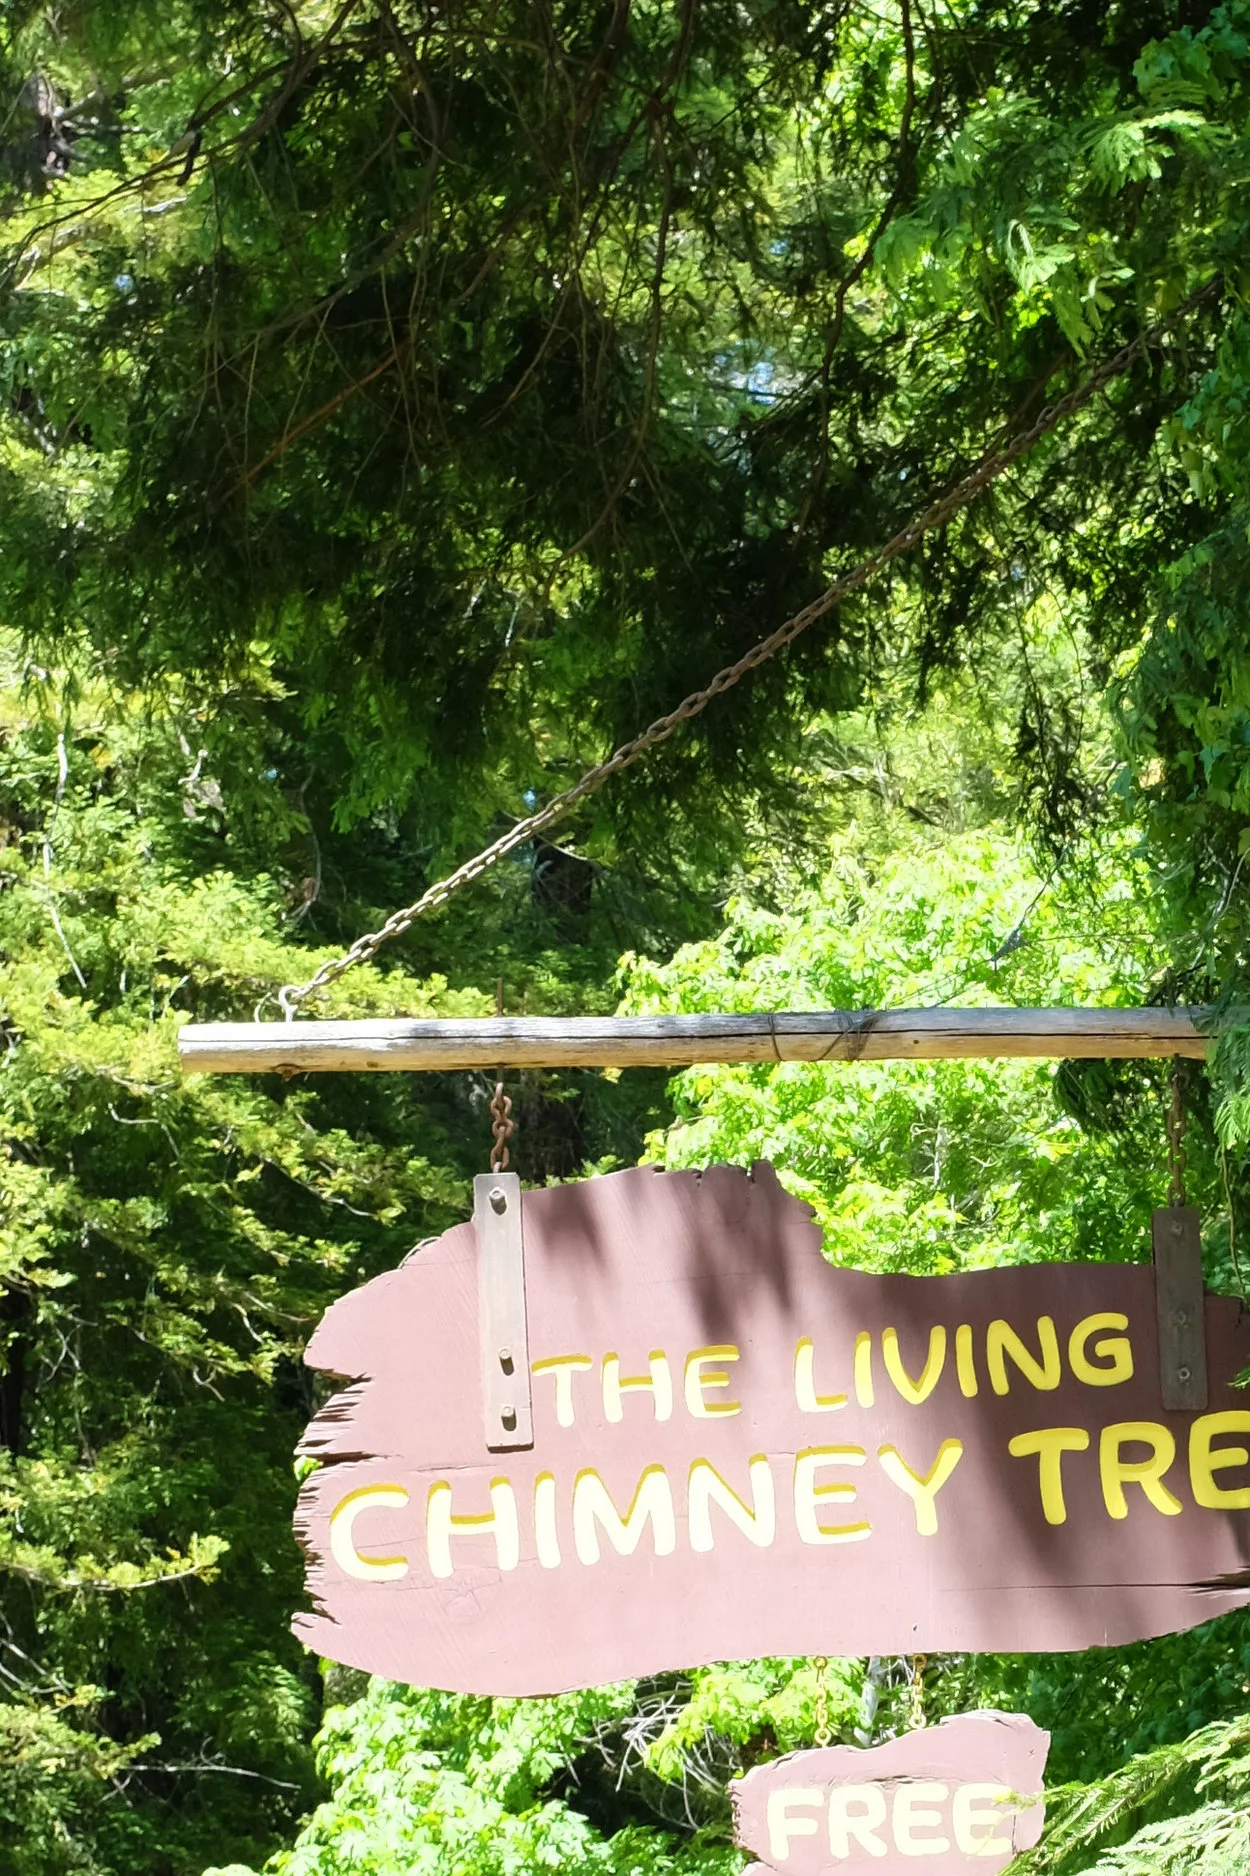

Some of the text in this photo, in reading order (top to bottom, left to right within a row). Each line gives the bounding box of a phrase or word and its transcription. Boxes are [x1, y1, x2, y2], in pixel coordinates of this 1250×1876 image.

[532, 1312, 1134, 1428] THE LIVING
[328, 1437, 963, 1582] CHIMNEY
[766, 1782, 1013, 1861] FREE
